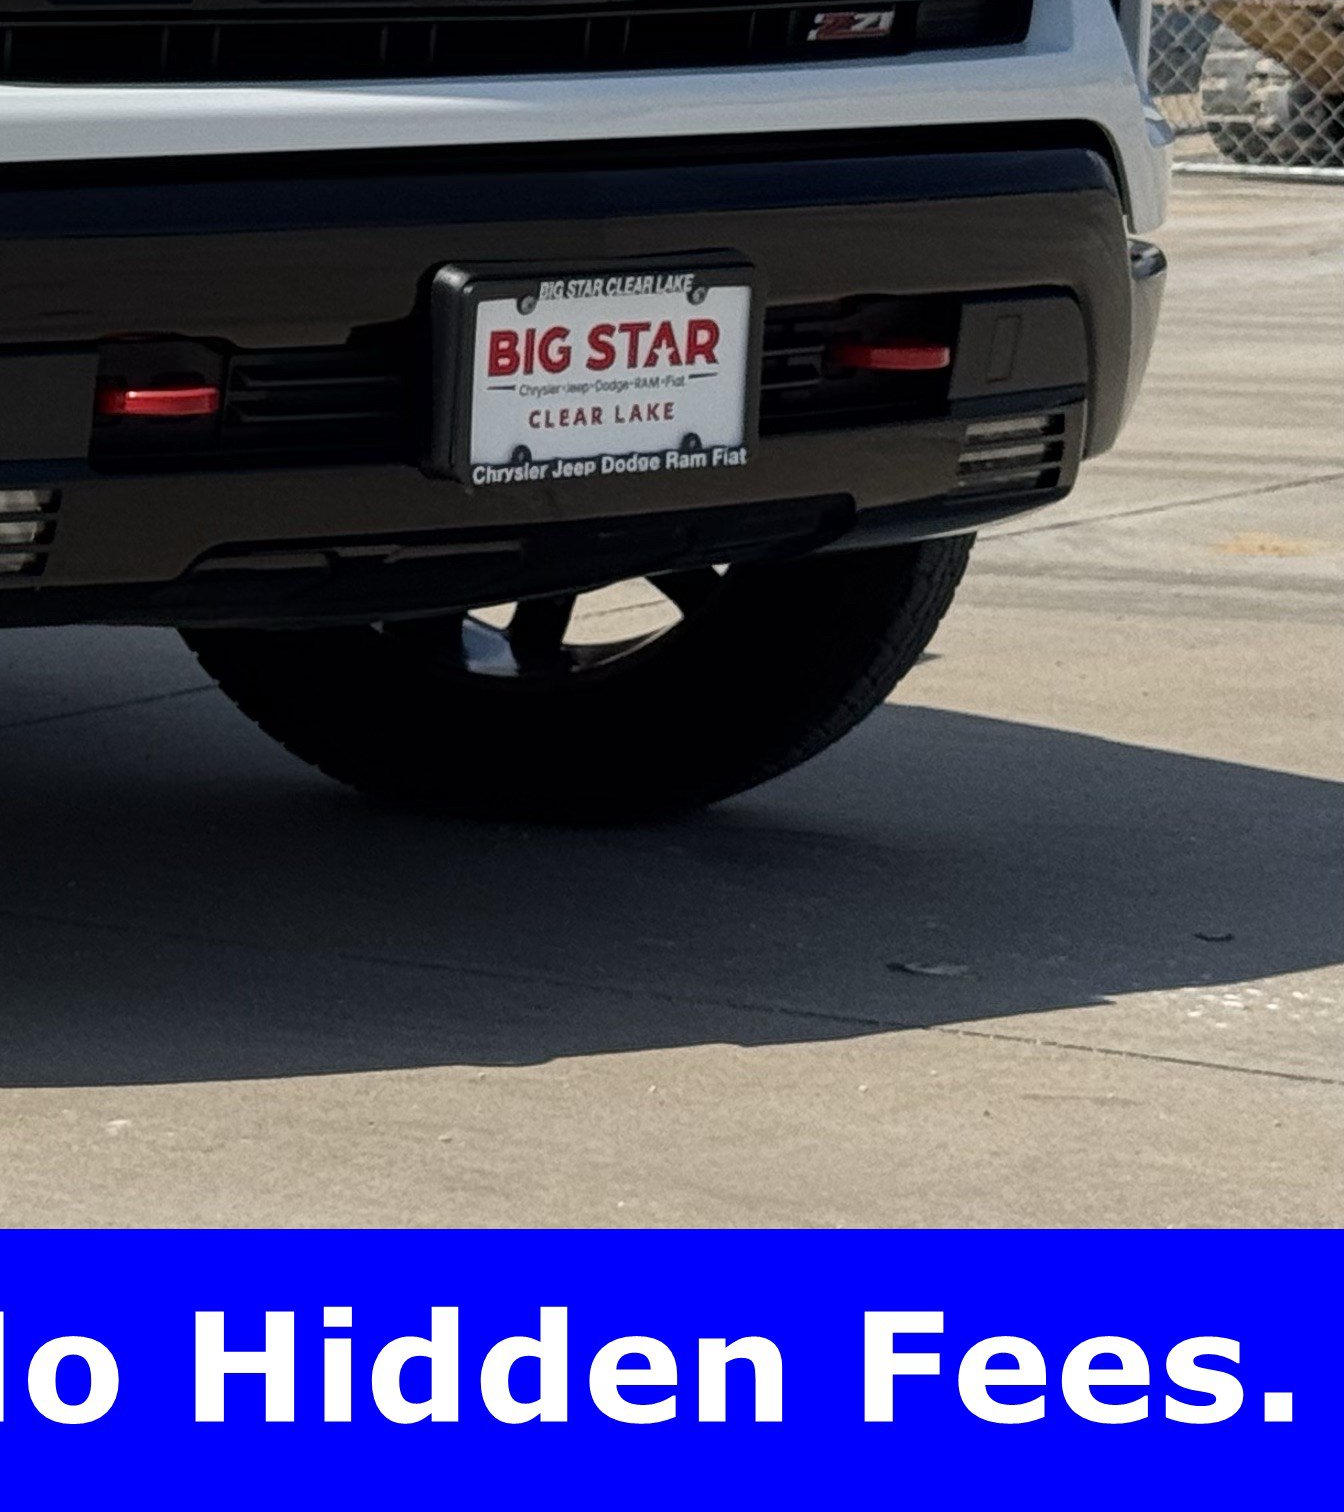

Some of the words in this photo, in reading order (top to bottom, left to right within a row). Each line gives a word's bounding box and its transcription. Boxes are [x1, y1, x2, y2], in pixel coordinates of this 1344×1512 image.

[807, 10, 896, 41] Z71
[540, 280, 564, 300] BIG
[566, 277, 604, 298] STAR
[606, 274, 655, 295] CLEAR
[656, 273, 695, 294] LAKE
[488, 326, 572, 377] BIG
[585, 319, 720, 370] STAR
[528, 407, 603, 429] CLEAR
[614, 402, 675, 424] LAKE
[472, 462, 548, 485] Chrysler
[554, 459, 597, 481] Jeep
[601, 455, 661, 474] Dodge
[665, 450, 706, 470] Ram
[712, 447, 748, 467] Fiat
